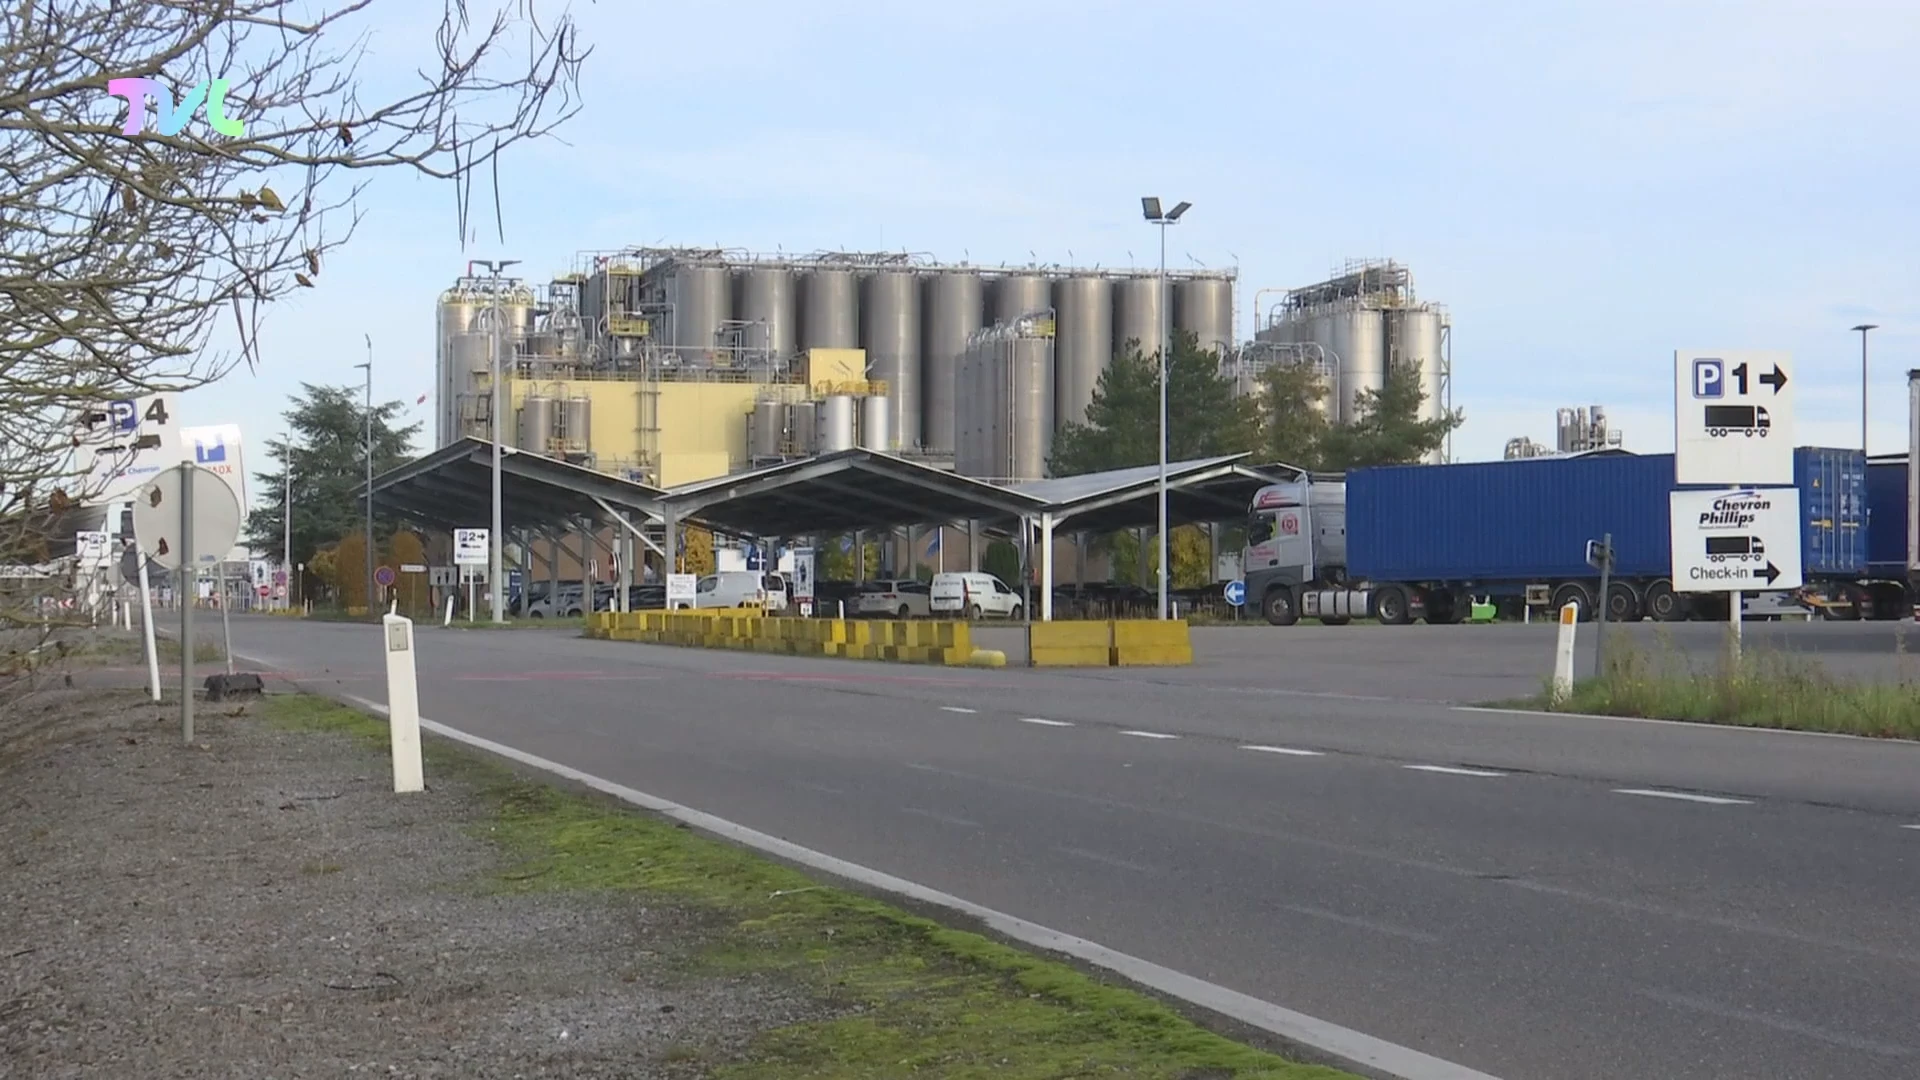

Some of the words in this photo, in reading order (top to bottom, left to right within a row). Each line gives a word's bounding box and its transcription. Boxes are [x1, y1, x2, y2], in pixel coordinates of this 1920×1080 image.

[1698, 363, 1720, 395] P
[1732, 362, 1748, 395] 1
[145, 398, 169, 425] 4
[1713, 499, 1771, 511] Chevron
[1699, 511, 1755, 529] Phillips
[1690, 566, 1748, 580] Check-in
